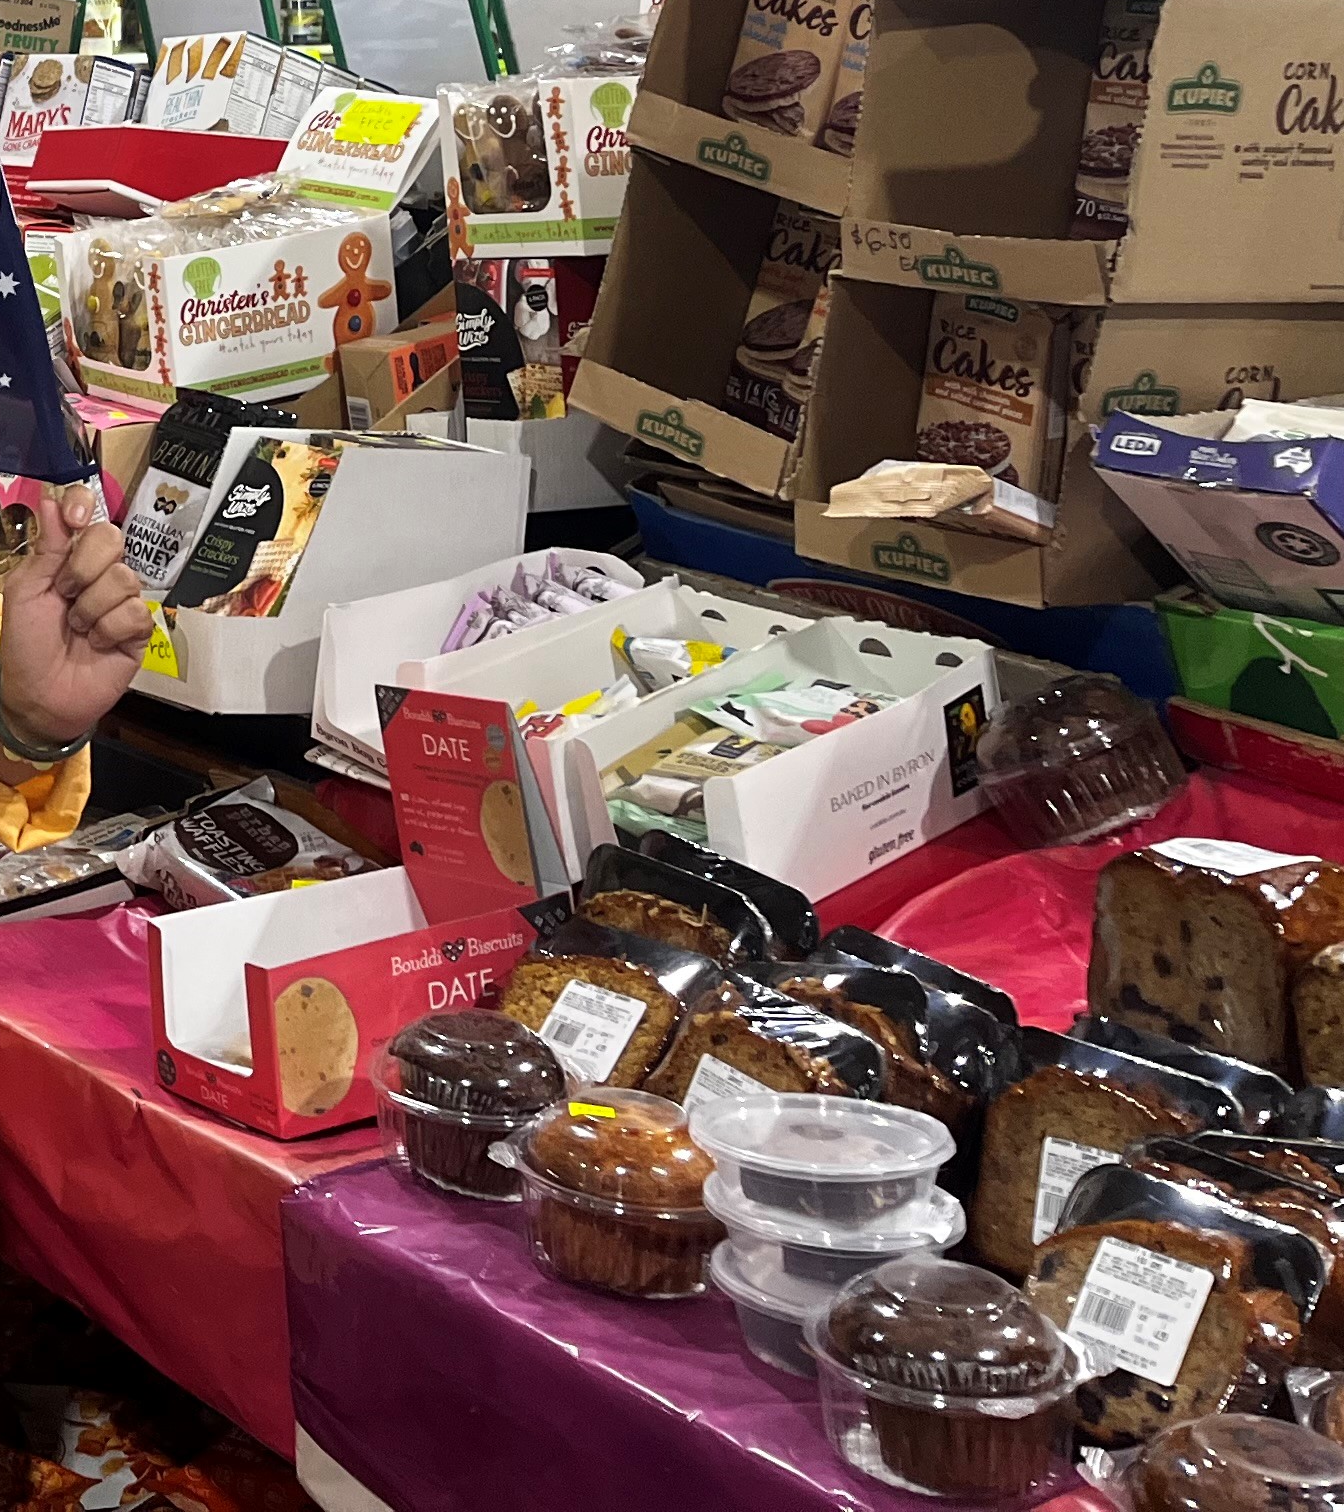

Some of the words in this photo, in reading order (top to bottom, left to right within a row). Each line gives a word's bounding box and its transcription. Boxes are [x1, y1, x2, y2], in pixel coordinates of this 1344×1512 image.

[1283, 61, 1332, 80] CORN
[1171, 88, 1238, 108] KUPIEC
[1276, 73, 1344, 136] Cak
[7, 103, 72, 138] MARY'S
[703, 145, 767, 179] KUPIEC
[1075, 197, 1096, 217] 70
[925, 263, 995, 287] KUPIEC
[179, 282, 270, 325] Christen's
[969, 297, 1018, 322] KUPIEC
[179, 300, 311, 347] GINGERBREAD
[455, 308, 495, 332] Simply
[940, 318, 977, 339] RICE
[932, 336, 1035, 397] Cakes
[1225, 365, 1275, 385] CORN
[641, 417, 702, 454] KUPIEC
[1115, 434, 1161, 455] LEDA
[228, 483, 272, 507] Simply
[126, 522, 181, 554] MANUKA
[131, 513, 186, 541] AUSTRALIAN
[123, 538, 176, 567] HONEY
[197, 544, 240, 566] Crackers
[204, 533, 236, 552] Crispy
[877, 551, 950, 580] KUPIEC
[421, 733, 472, 763] DATE
[829, 780, 876, 813] BAKED
[877, 772, 891, 790] IN
[892, 748, 936, 784] BYRON
[180, 817, 252, 875] WAFFLES
[193, 810, 266, 872] TOASTING
[391, 948, 443, 978] Bouddi
[467, 930, 524, 958] Biscuits
[427, 968, 496, 1010] DATE
[199, 1084, 230, 1110] DATE
